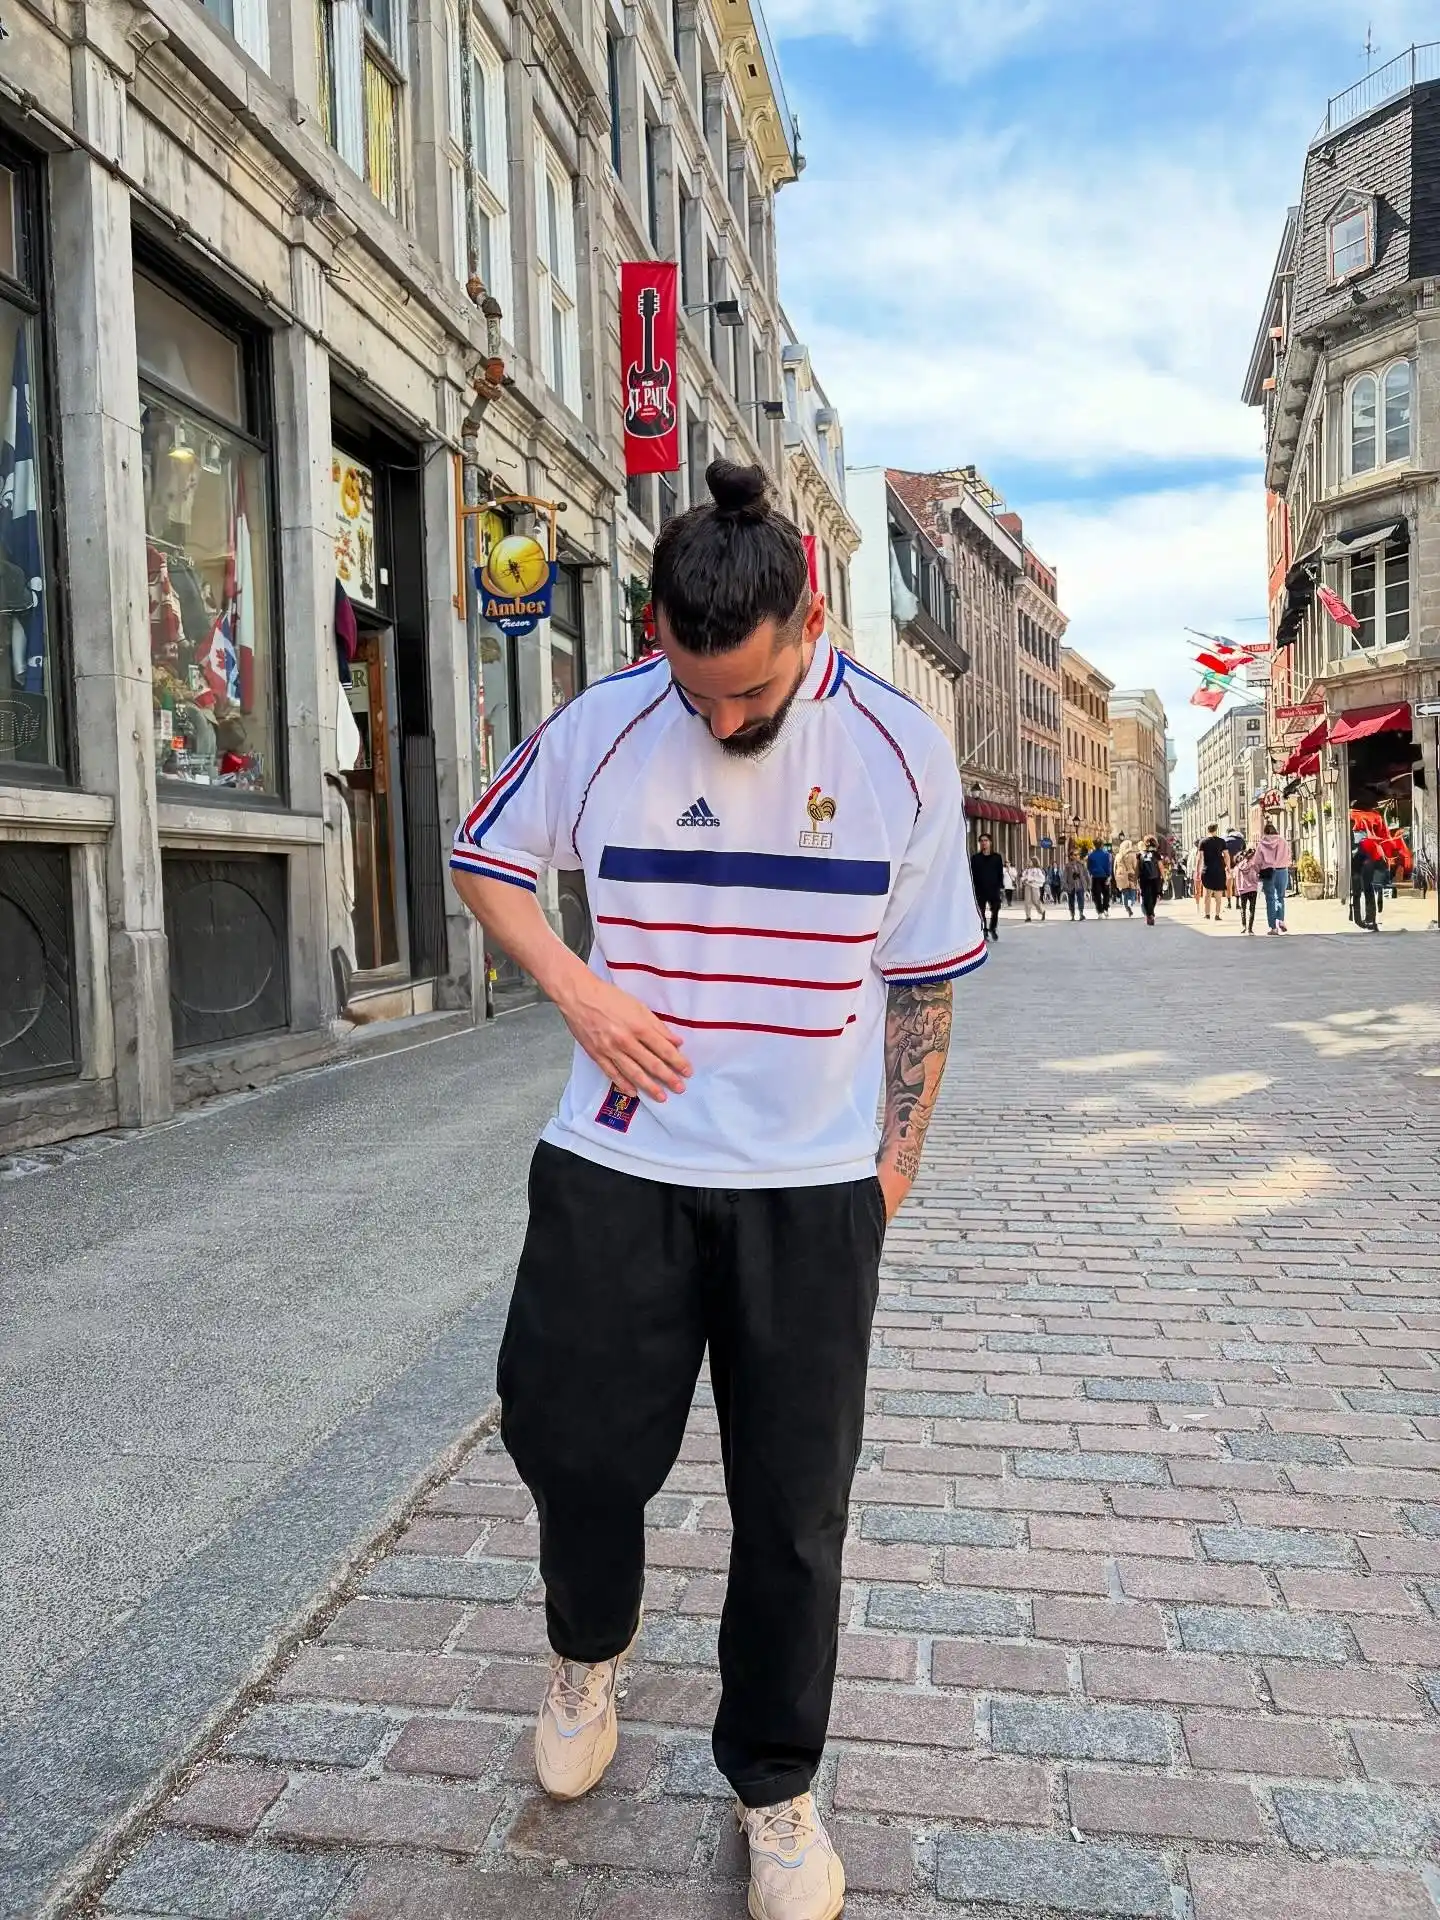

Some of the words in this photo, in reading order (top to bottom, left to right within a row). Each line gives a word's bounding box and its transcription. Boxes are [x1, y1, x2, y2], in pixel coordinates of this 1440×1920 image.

[643, 386, 670, 419] PAUL
[485, 597, 546, 617] Amber
[676, 815, 721, 828] adidas
